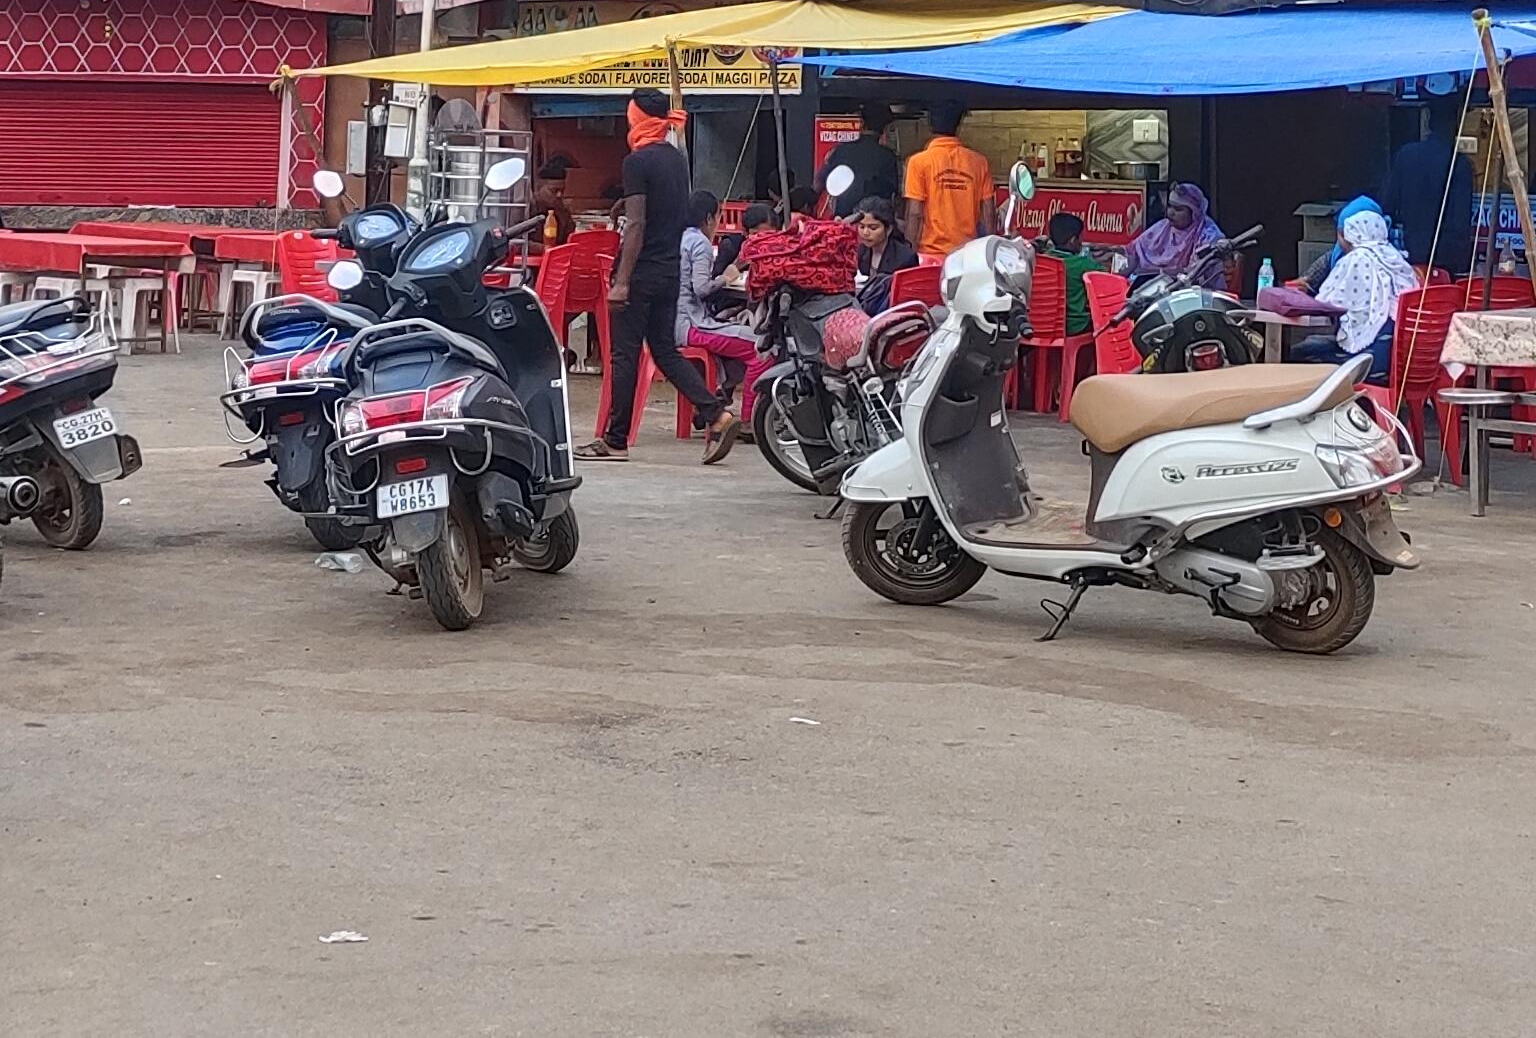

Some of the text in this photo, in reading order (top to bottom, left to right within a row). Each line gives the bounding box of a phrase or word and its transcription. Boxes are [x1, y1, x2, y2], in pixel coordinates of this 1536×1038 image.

[578, 73, 606, 84] SODA
[715, 73, 751, 84] MAGGI
[759, 72, 797, 84] PIZA
[1087, 200, 1124, 233] Aroma
[63, 420, 113, 444] 3820
[390, 478, 434, 499] CG17K
[390, 493, 435, 513] W8653
